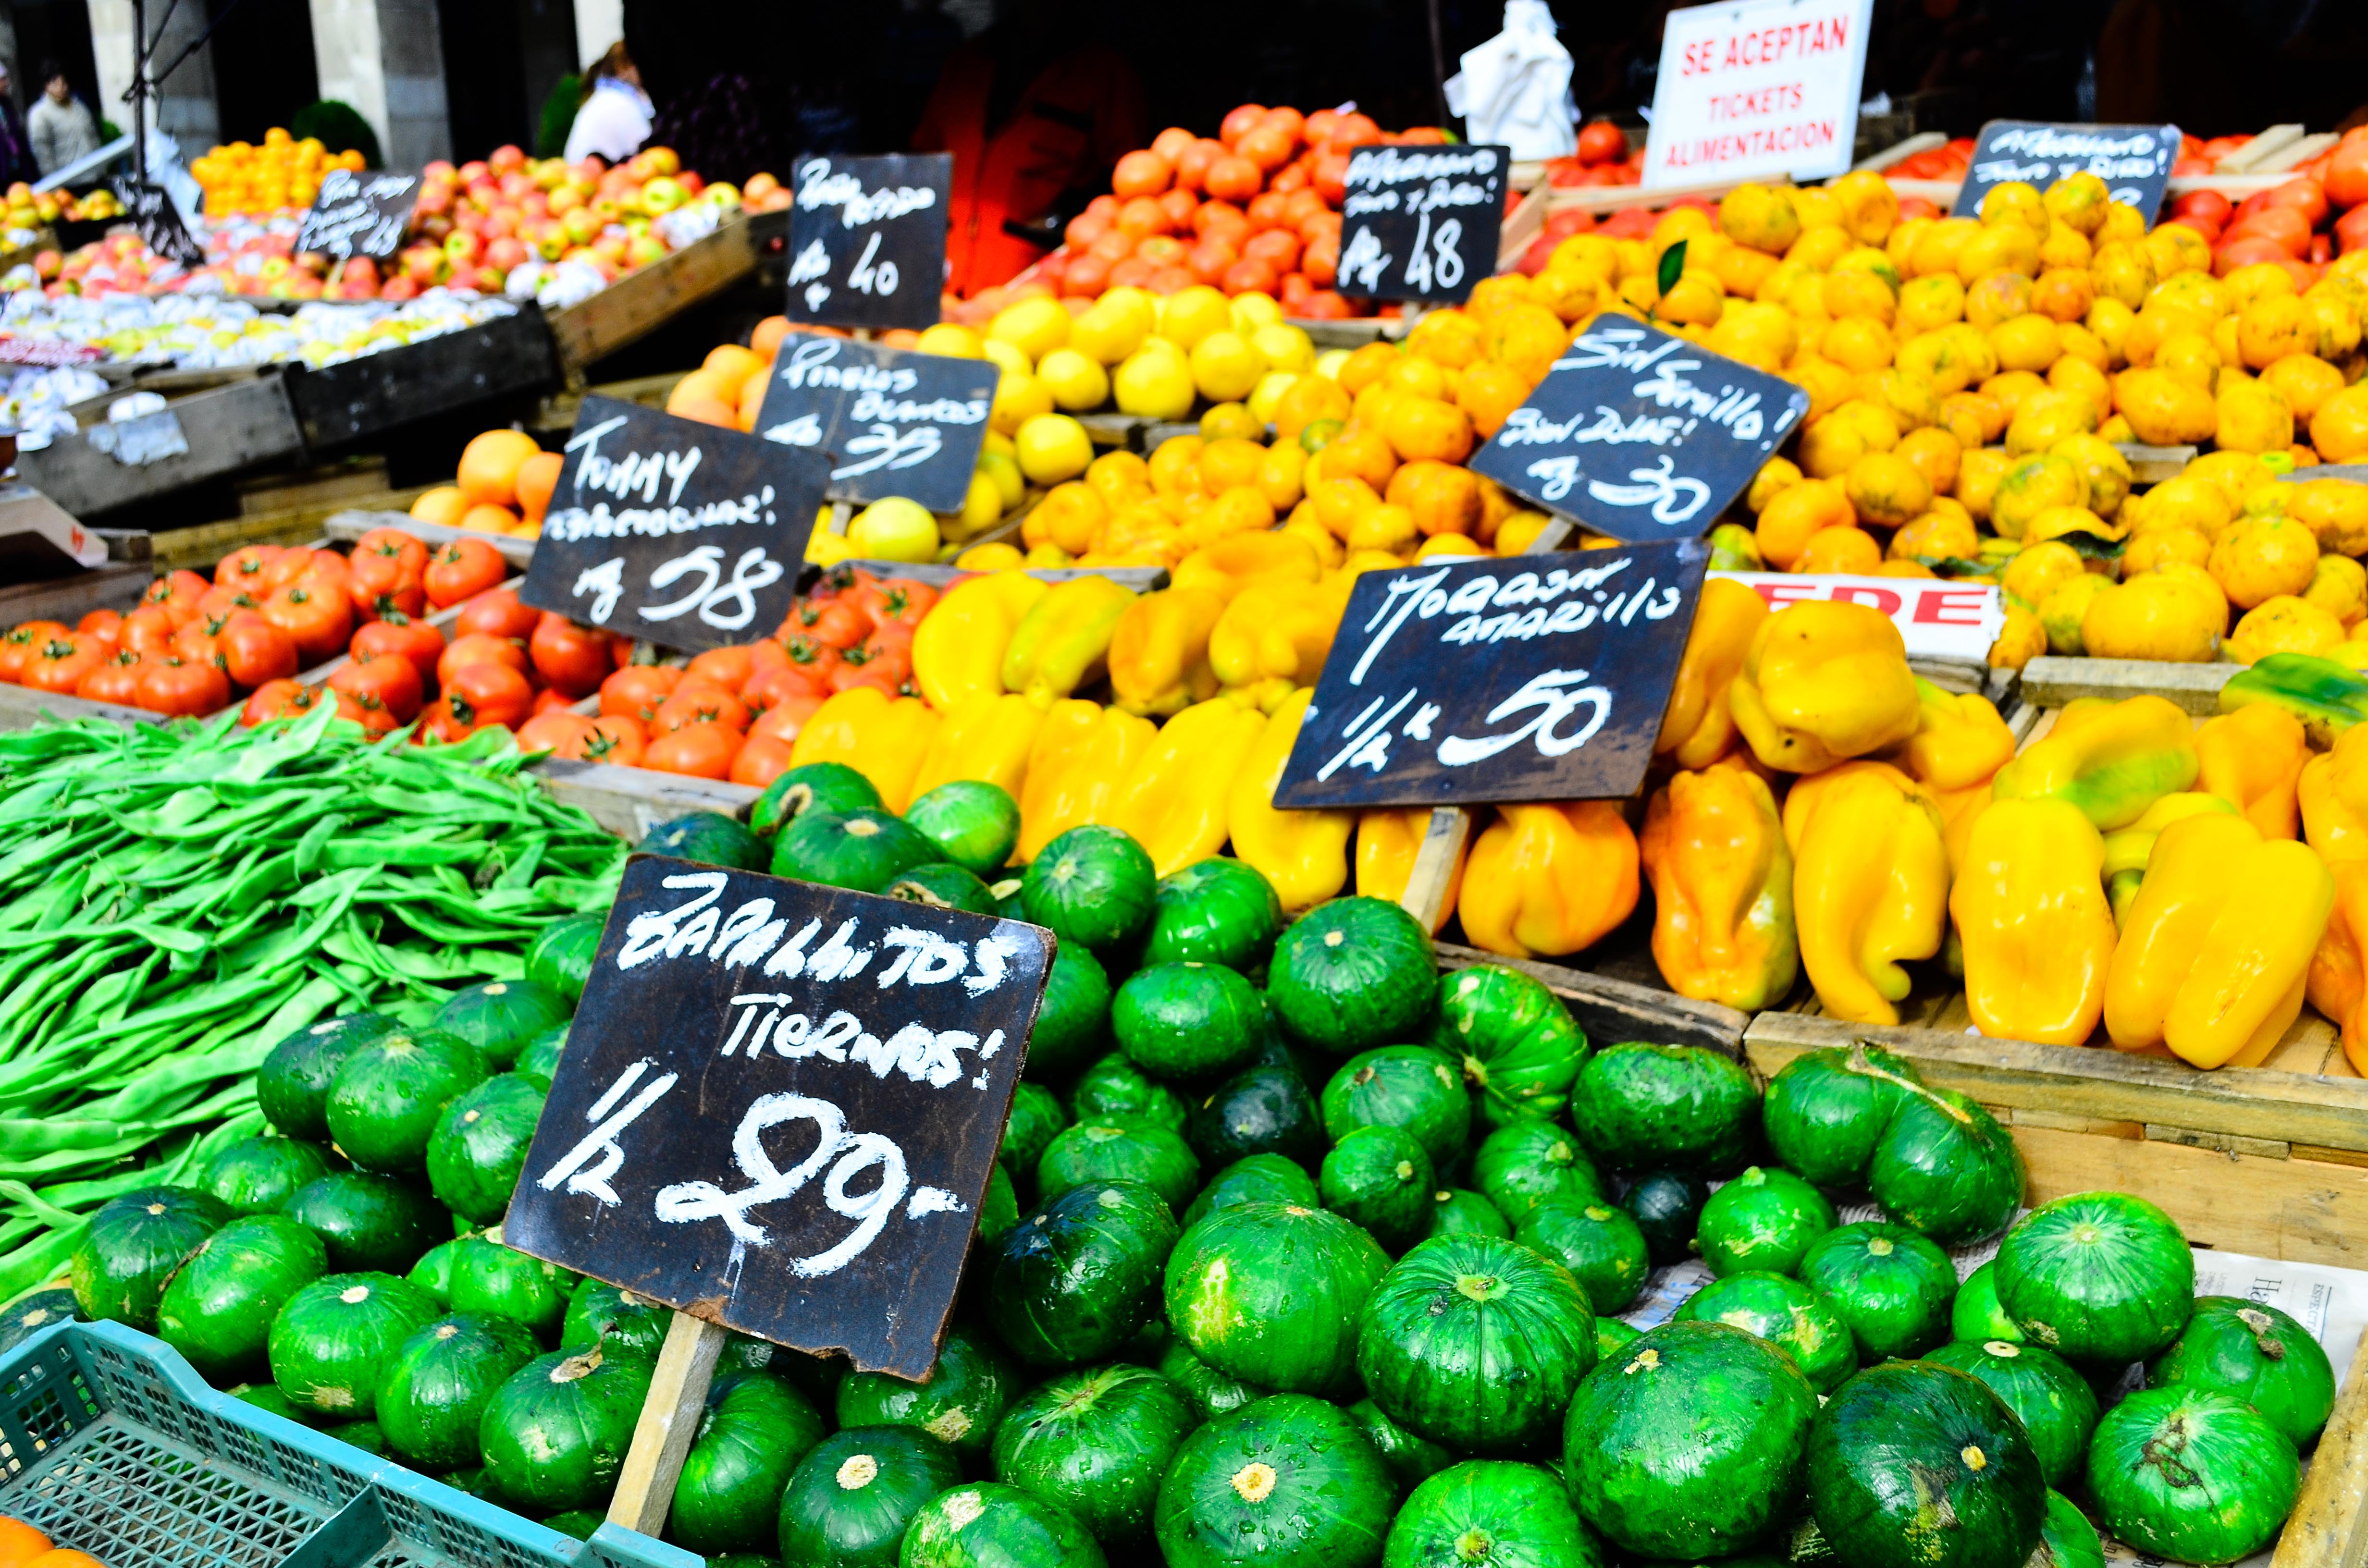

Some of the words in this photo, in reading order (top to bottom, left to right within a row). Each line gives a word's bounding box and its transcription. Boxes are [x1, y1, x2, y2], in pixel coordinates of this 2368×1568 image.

[1683, 40, 1715, 76] SE
[1723, 15, 1849, 69] ACEPTAN
[1709, 82, 1803, 120] TICKETS
[1666, 120, 1836, 167] ALIMENTACION
[848, 231, 899, 296] 40
[1404, 212, 1465, 294] 48
[638, 546, 784, 631] 58
[1437, 669, 1613, 766] 50
